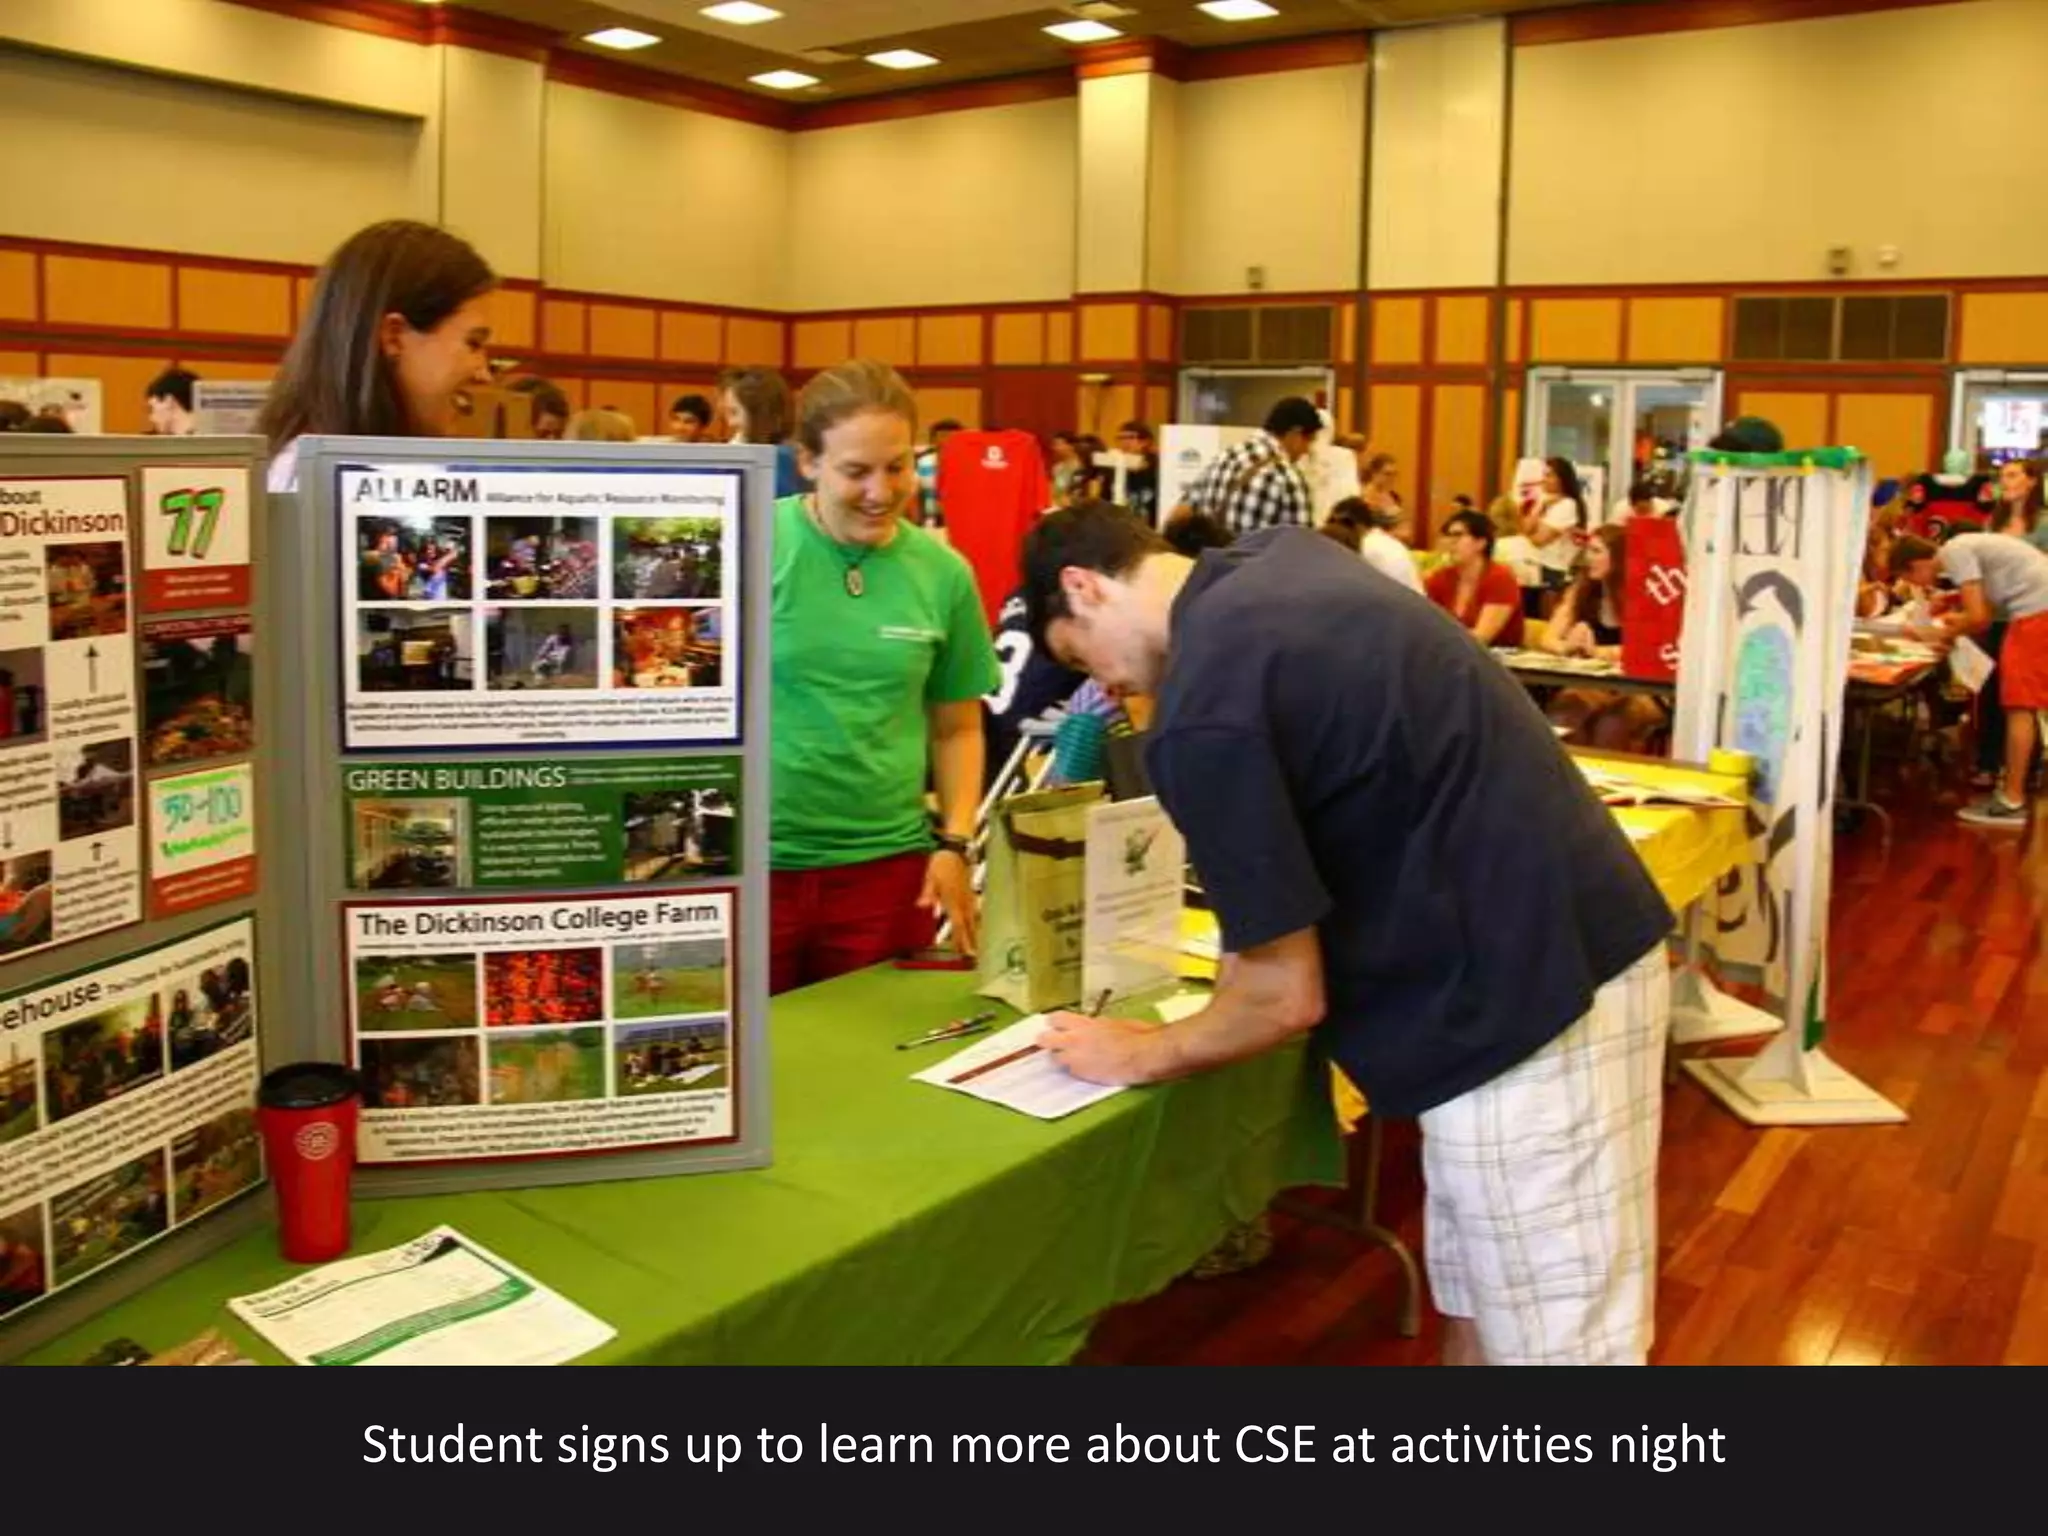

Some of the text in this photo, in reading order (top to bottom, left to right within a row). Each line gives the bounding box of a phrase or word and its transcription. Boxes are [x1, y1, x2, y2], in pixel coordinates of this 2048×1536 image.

[0, 508, 123, 537] Dickinson
[349, 769, 428, 791] GREEN
[435, 765, 567, 790] BUILDINGS
[357, 902, 719, 937] The Dickinson College Farm
